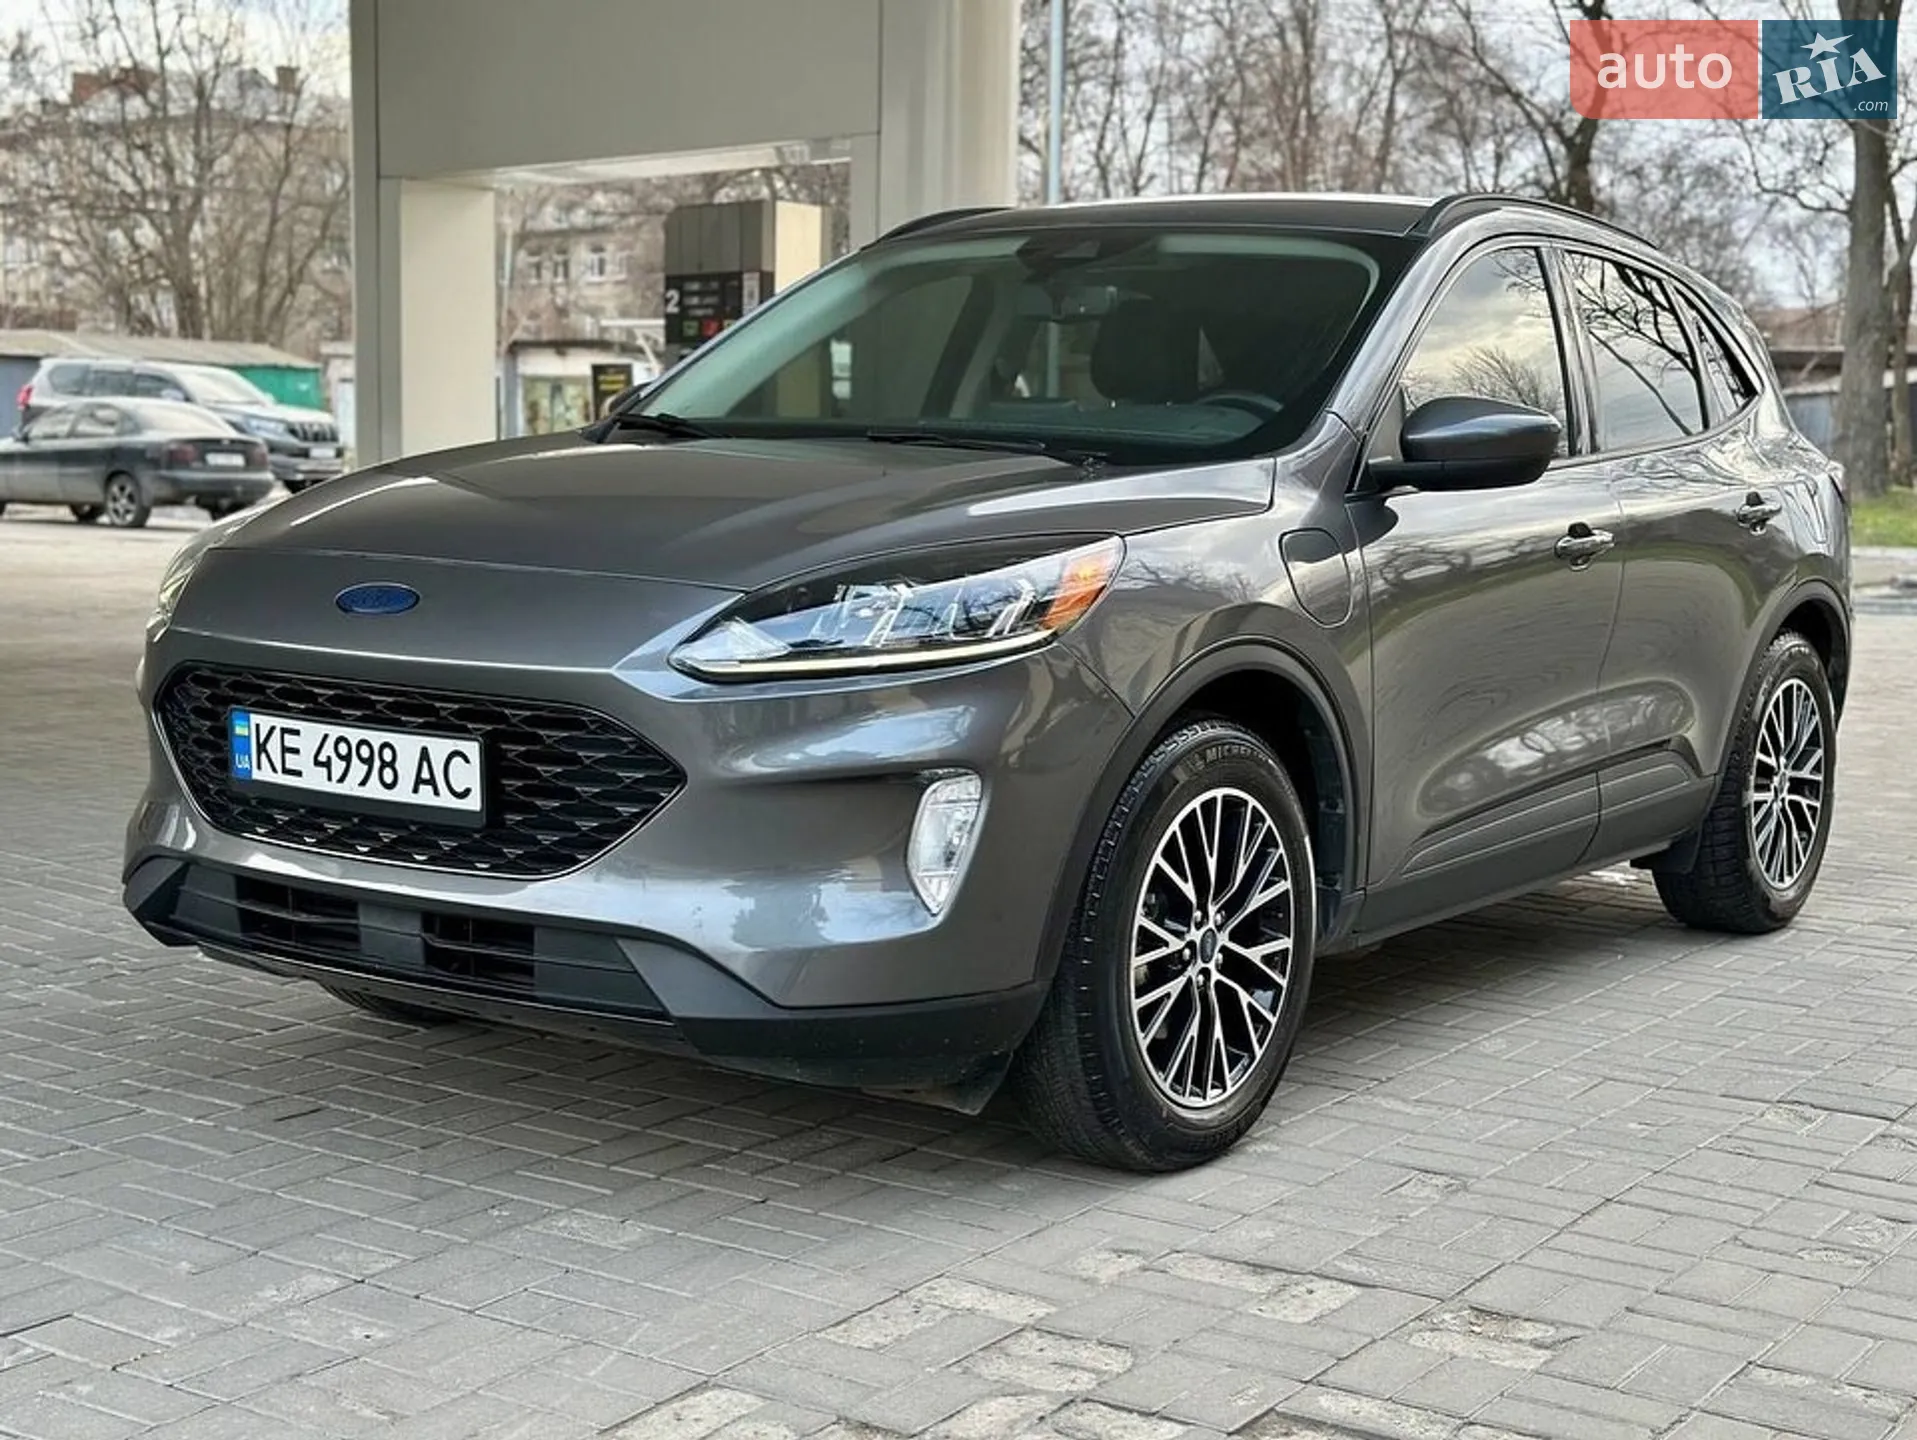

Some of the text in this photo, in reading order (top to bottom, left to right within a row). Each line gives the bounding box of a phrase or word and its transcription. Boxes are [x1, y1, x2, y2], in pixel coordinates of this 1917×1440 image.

[665, 288, 680, 314] 2
[235, 753, 250, 770] UA
[255, 722, 472, 800] KE 4998 AC
[1205, 744, 1267, 763] MICHE
